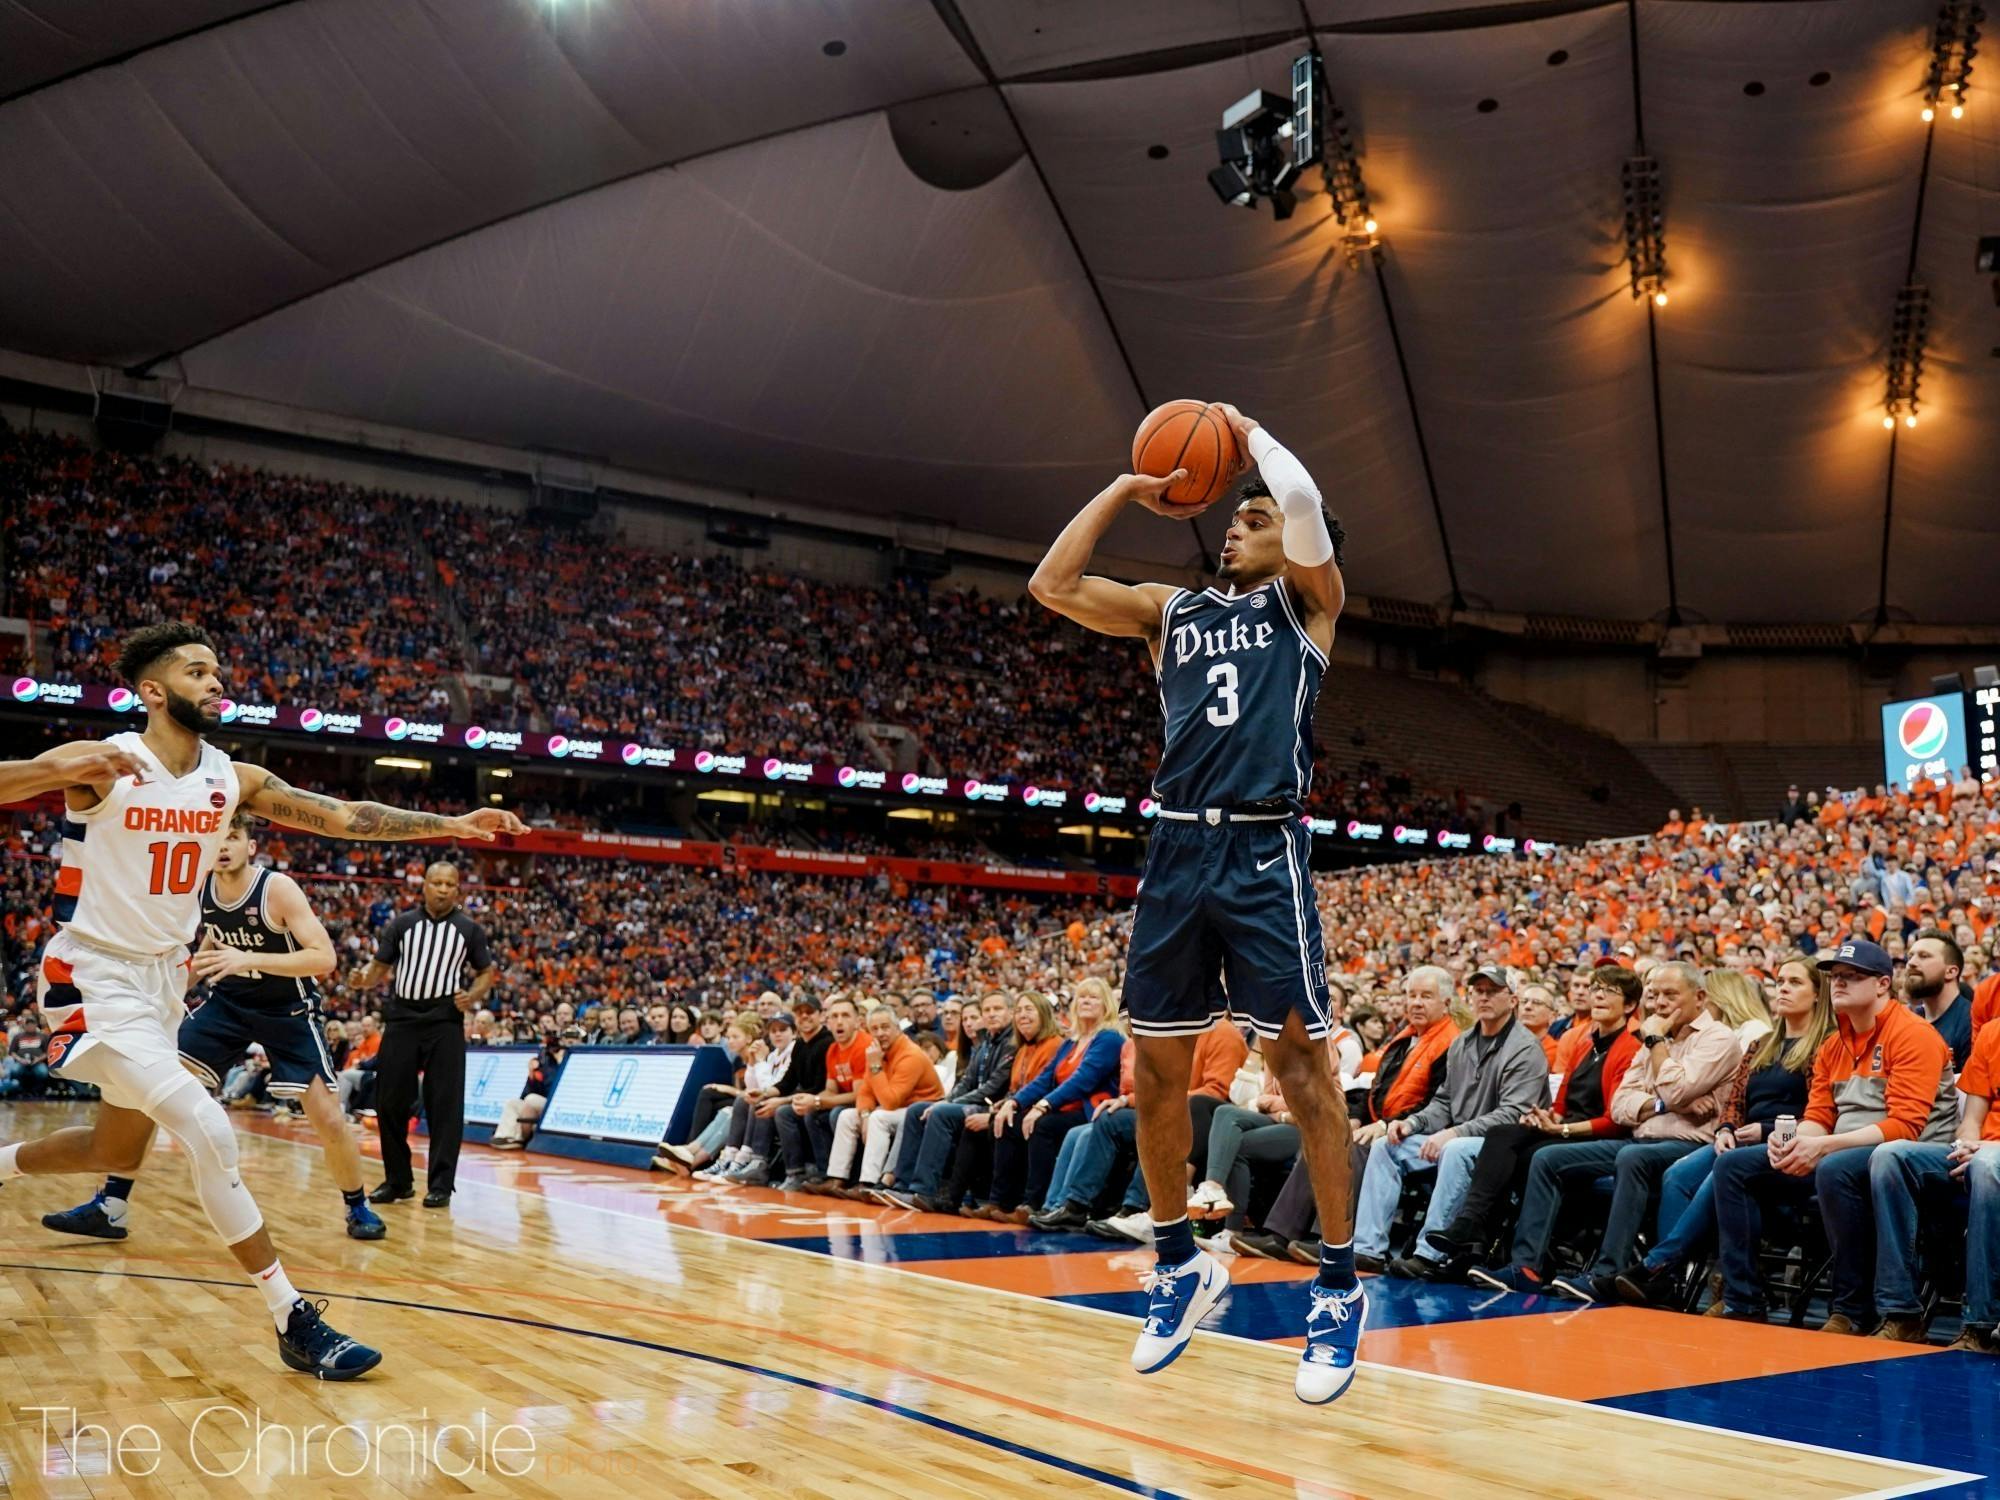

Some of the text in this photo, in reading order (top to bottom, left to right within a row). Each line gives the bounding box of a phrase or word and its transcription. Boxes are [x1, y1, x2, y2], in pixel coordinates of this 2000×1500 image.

[1172, 614, 1274, 668] Duke
[39, 683, 83, 699] pepsi
[1206, 662, 1239, 727] 3
[236, 704, 277, 718] pepsi
[124, 807, 223, 834] ORANGE
[148, 841, 202, 895] 10
[204, 922, 265, 947] Duke
